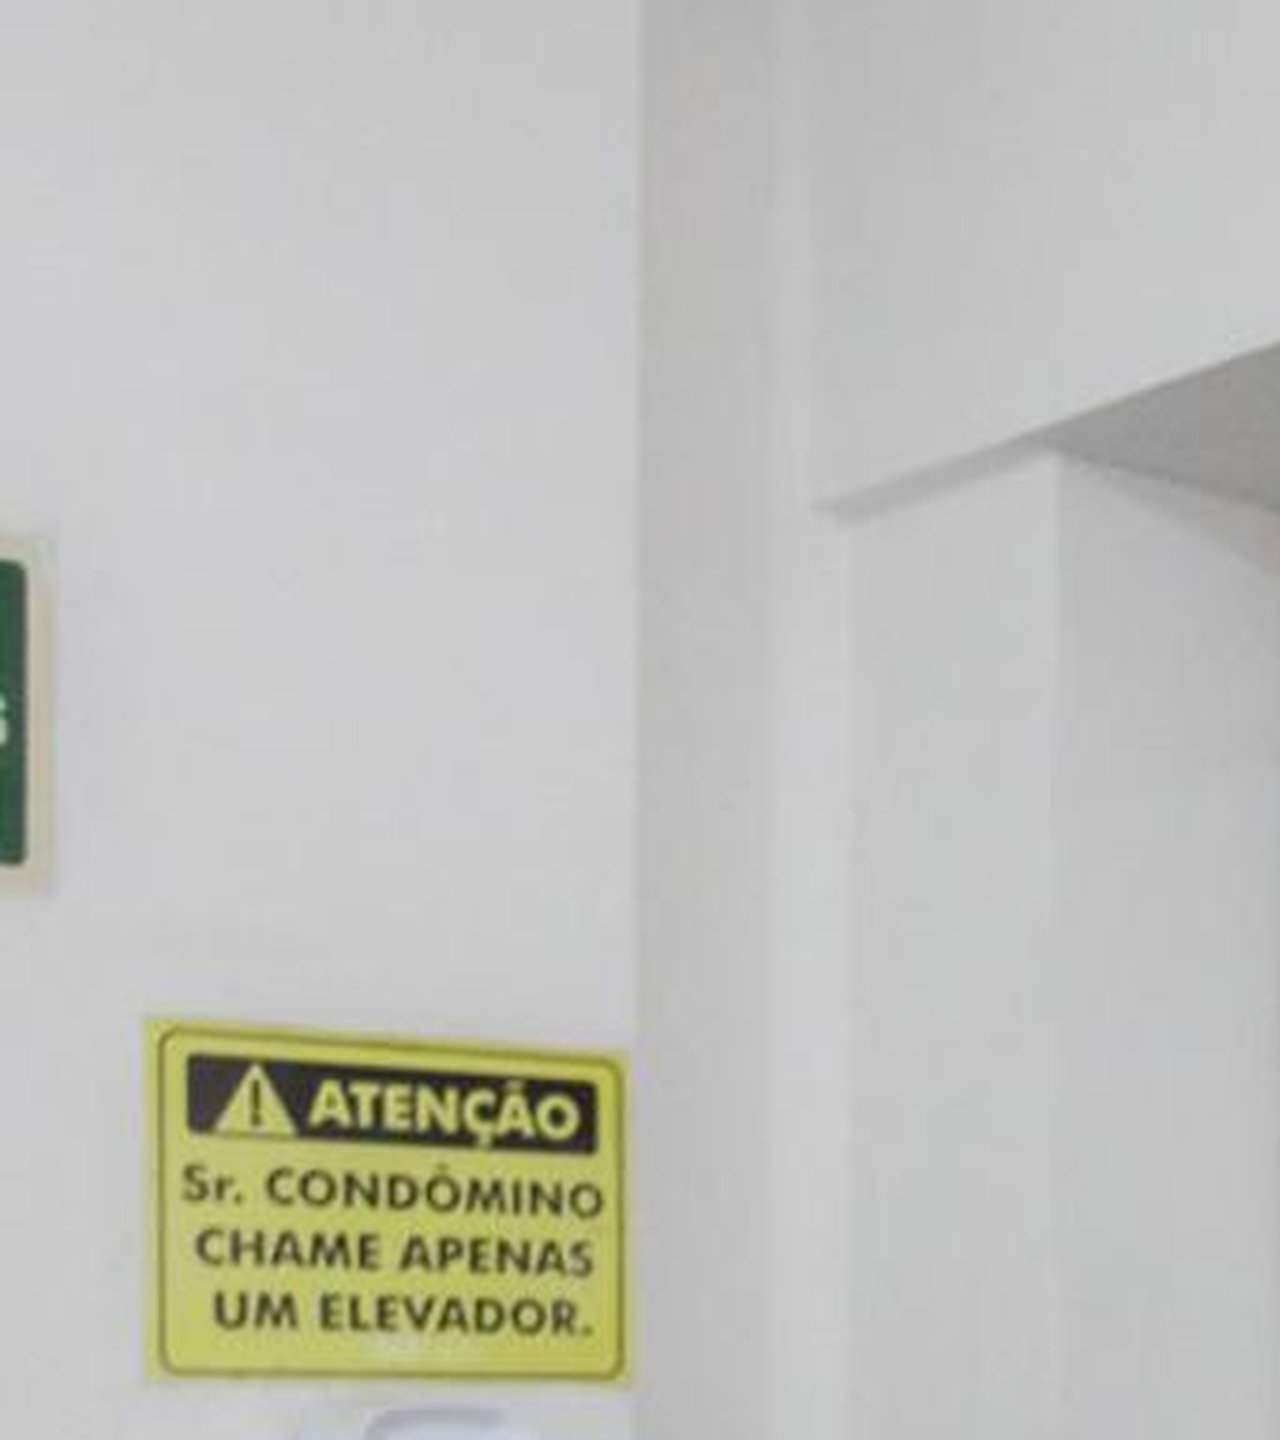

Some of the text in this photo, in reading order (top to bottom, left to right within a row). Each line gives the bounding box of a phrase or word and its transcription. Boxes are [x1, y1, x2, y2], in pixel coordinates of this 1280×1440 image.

[309, 1079, 581, 1150] ATENÇÃO
[183, 1161, 604, 1220] Sr. CONDÔMINO
[194, 1227, 595, 1278] CHAME APENAS
[213, 1291, 596, 1337] UM ELEVADOR.
